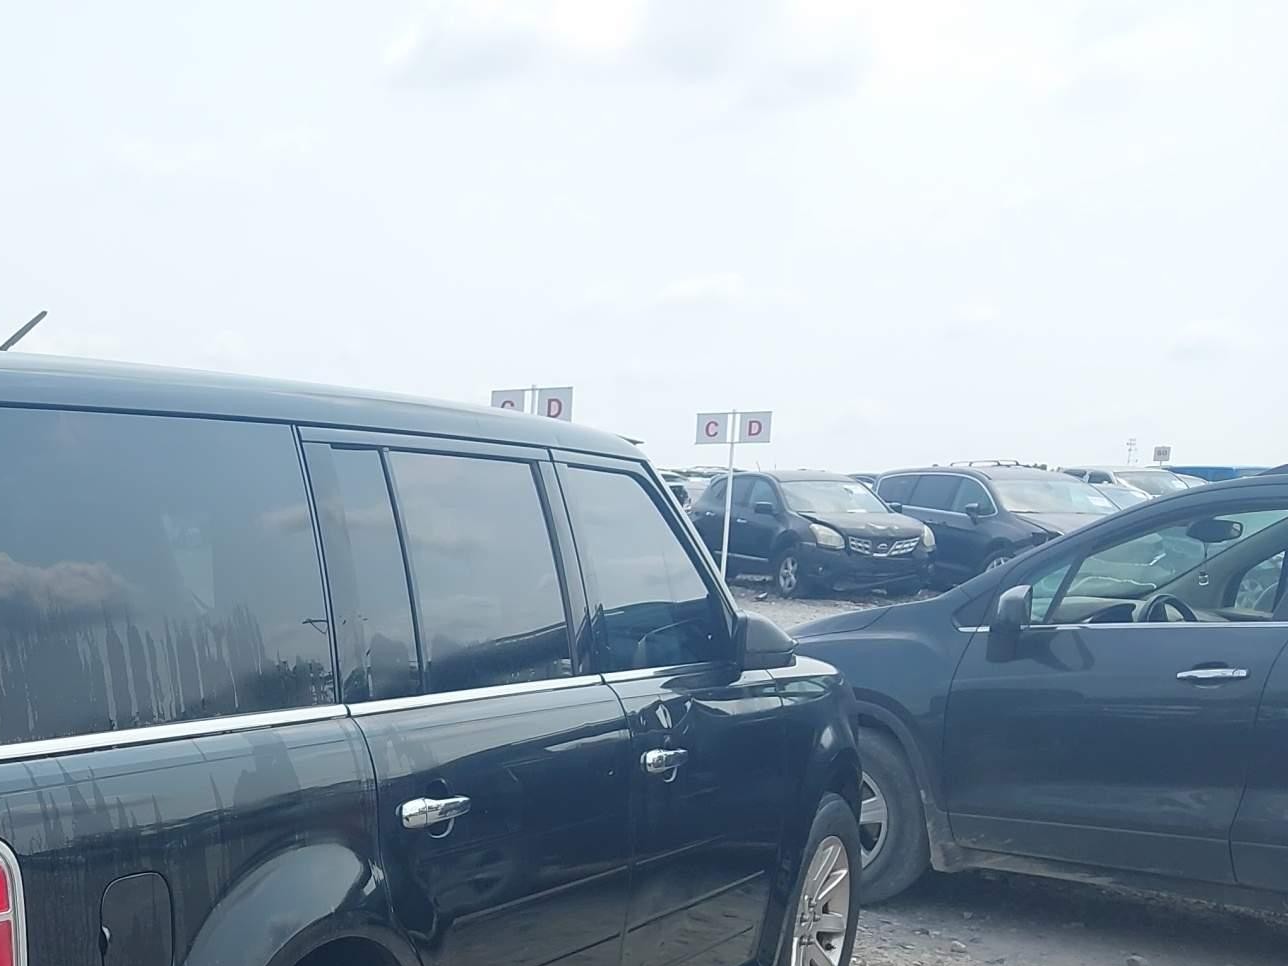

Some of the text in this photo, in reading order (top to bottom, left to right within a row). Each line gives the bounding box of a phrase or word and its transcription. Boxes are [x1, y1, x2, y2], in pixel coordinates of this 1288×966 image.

[547, 398, 562, 418] D
[705, 420, 762, 437] C D
